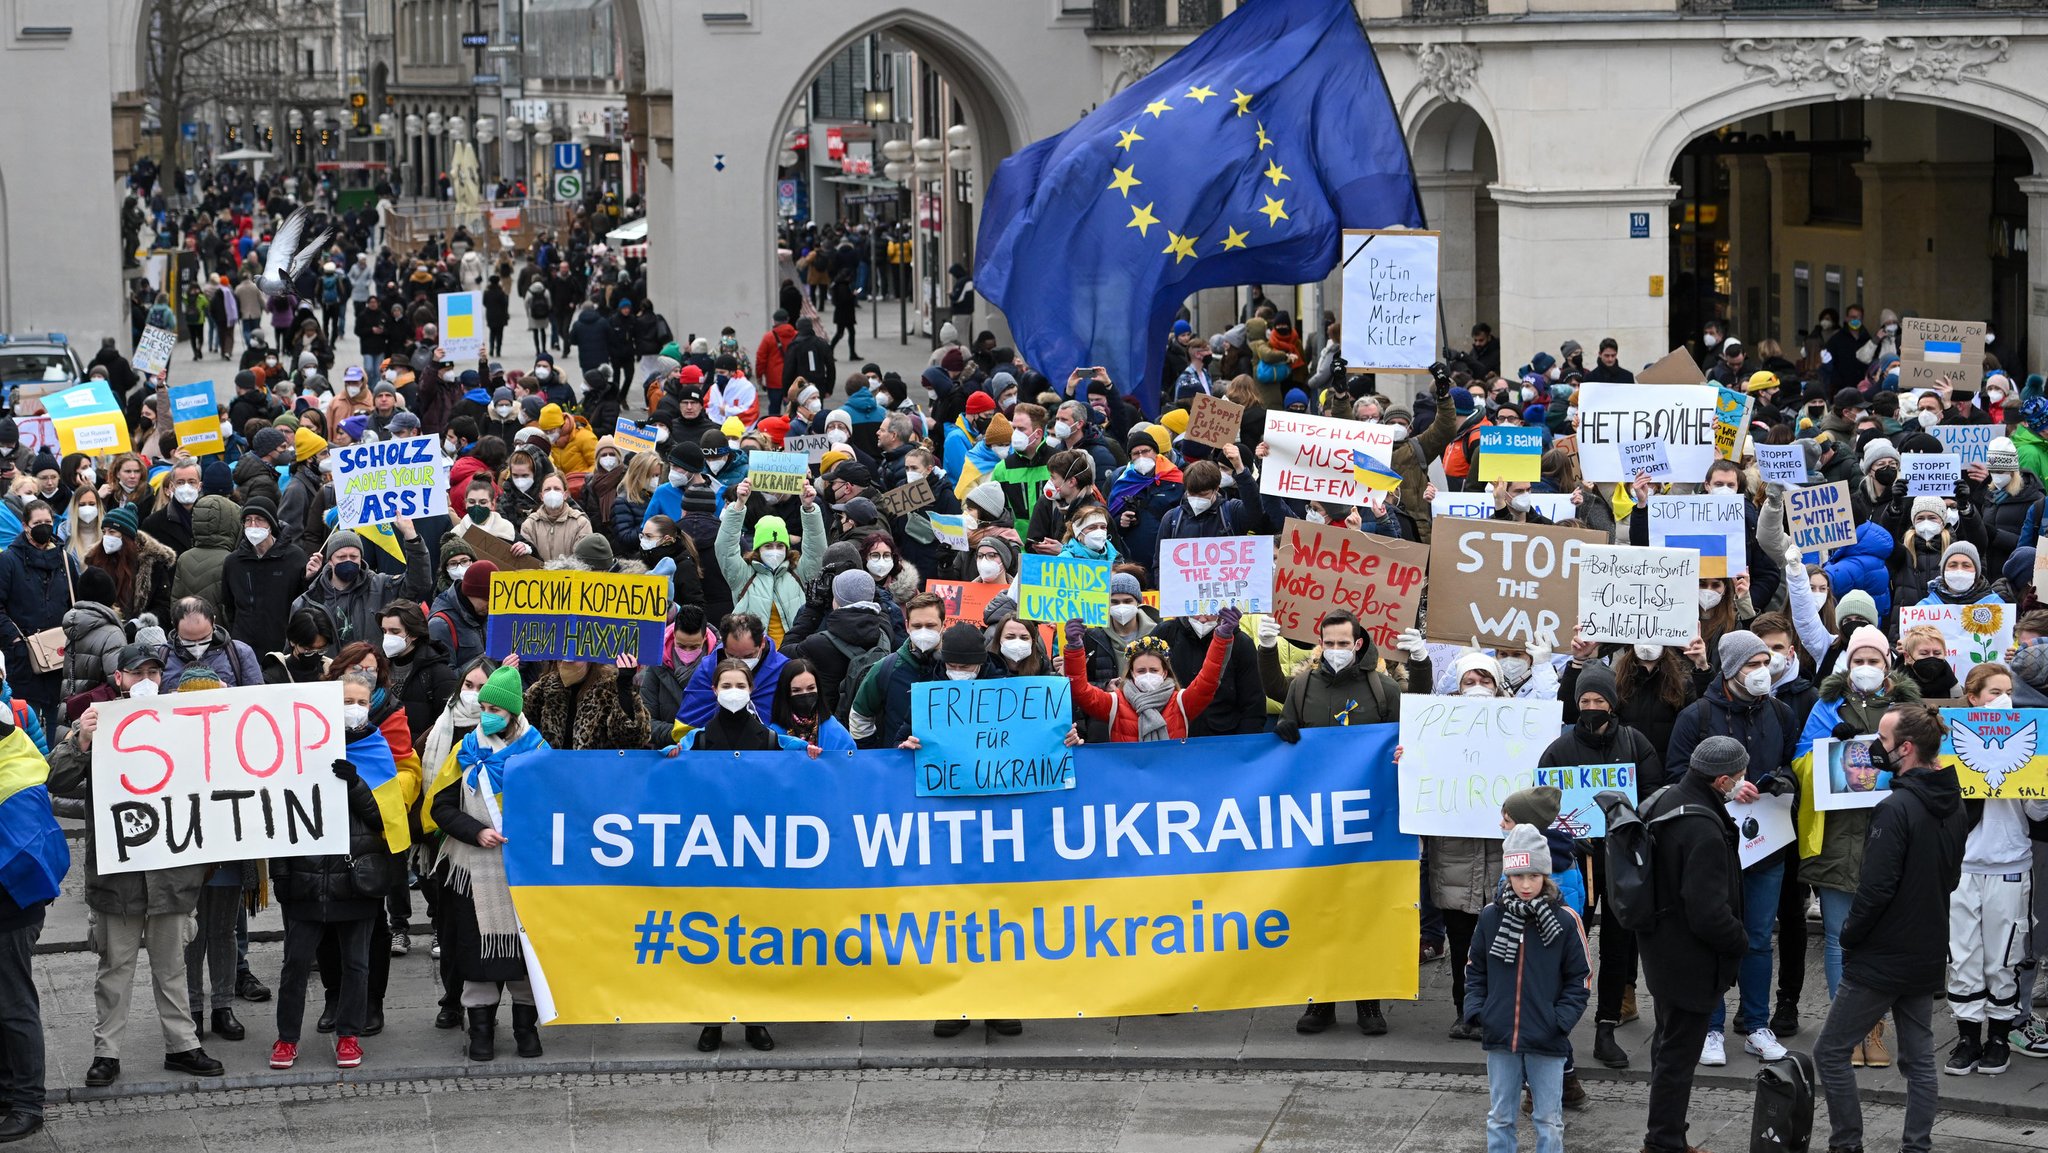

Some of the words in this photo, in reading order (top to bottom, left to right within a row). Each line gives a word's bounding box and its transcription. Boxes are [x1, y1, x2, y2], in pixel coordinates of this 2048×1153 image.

[560, 145, 576, 168] U
[561, 177, 578, 197] S
[1634, 215, 1646, 227] 10
[1371, 258, 1410, 280] Putin
[1369, 281, 1436, 303] Verbrecher
[1369, 304, 1421, 325] Mörder
[145, 328, 176, 345] #CLOSE
[1367, 325, 1417, 346] Killer
[1907, 320, 1958, 334] FREEDOM
[1965, 326, 1982, 336] FOR
[142, 336, 157, 350] THE
[158, 343, 172, 356] SKY
[1913, 367, 1934, 379] NO
[1943, 369, 1966, 381] WAR
[1198, 398, 1241, 425] Stoppt
[619, 422, 636, 432] STOP
[1194, 411, 1231, 435] Putins
[1268, 419, 1393, 445] DEUTSCHLAND
[1581, 411, 1629, 444] НЕТ
[1633, 402, 1714, 445] ВОЙНЕ
[182, 435, 203, 444] SWIFT
[790, 440, 804, 452] NO
[807, 436, 829, 450] WAR
[1190, 425, 1220, 443] GAS
[340, 438, 434, 474] SCHOLZ
[767, 453, 792, 462] PUTIN
[1625, 442, 1657, 455] STOPPT
[1761, 450, 1793, 459] STOPPT
[1631, 454, 1655, 465] PUTIN
[1759, 461, 1772, 469] DEN
[1773, 461, 1802, 469] KRIEG
[1912, 461, 1951, 471] STOPPT
[344, 469, 388, 495] MOVE
[391, 465, 435, 488] YOUR
[753, 473, 803, 493] UKRAINE
[1905, 472, 1925, 481] DEN
[1928, 472, 1958, 481] KRIEG
[884, 482, 931, 514] PEACE
[1791, 485, 1839, 511] STAND
[1652, 501, 1686, 519] STOP
[1690, 502, 1714, 521] THE
[1717, 503, 1745, 521] WAR
[1804, 509, 1835, 525] WITH
[1793, 520, 1853, 548] UKRAINE
[1172, 541, 1256, 567] CLOSE
[1292, 530, 1380, 576] Wake
[1041, 562, 1107, 592] HANDS
[1180, 567, 1212, 583] THE
[1218, 566, 1251, 582] SKY
[1387, 562, 1422, 597] up
[493, 576, 571, 611] РУССКИЙ
[580, 581, 667, 618] КОРАБЛЬ
[1057, 588, 1080, 599] OFF
[1198, 580, 1249, 599] HELP
[1275, 568, 1325, 601] Nato
[1332, 577, 1402, 622] before
[1497, 578, 1540, 599] THE
[1591, 583, 1685, 611] #CloseTheSky
[1274, 600, 1301, 629] it's
[1469, 602, 1560, 647] WAR
[1580, 612, 1689, 640] #SendNatoToUkraine
[512, 620, 557, 656] ИДИ
[563, 621, 640, 661] НАХУЙ
[1415, 703, 1541, 740] PEACE
[1967, 711, 2002, 722] UNITED
[2006, 711, 2021, 722] WE
[976, 727, 1010, 750] FÜR
[1978, 725, 2012, 737] STAND
[113, 702, 331, 796] STOP
[1463, 748, 1480, 764] in
[1538, 769, 1575, 790] KEIN
[1580, 766, 1635, 788] KRIEG!
[1415, 769, 1534, 815] EUROP
[2018, 786, 2047, 797] FALL
[110, 783, 325, 863] PUTIN
[551, 812, 566, 866] I
[590, 812, 831, 869] STAND
[852, 808, 1026, 868] WITH
[1052, 788, 1374, 861] UKRAINE
[1744, 842, 1753, 850] NO
[1753, 835, 1766, 846] WAR
[1504, 854, 1530, 869] MARVEL
[633, 899, 1291, 967] #StandWithUkraine
